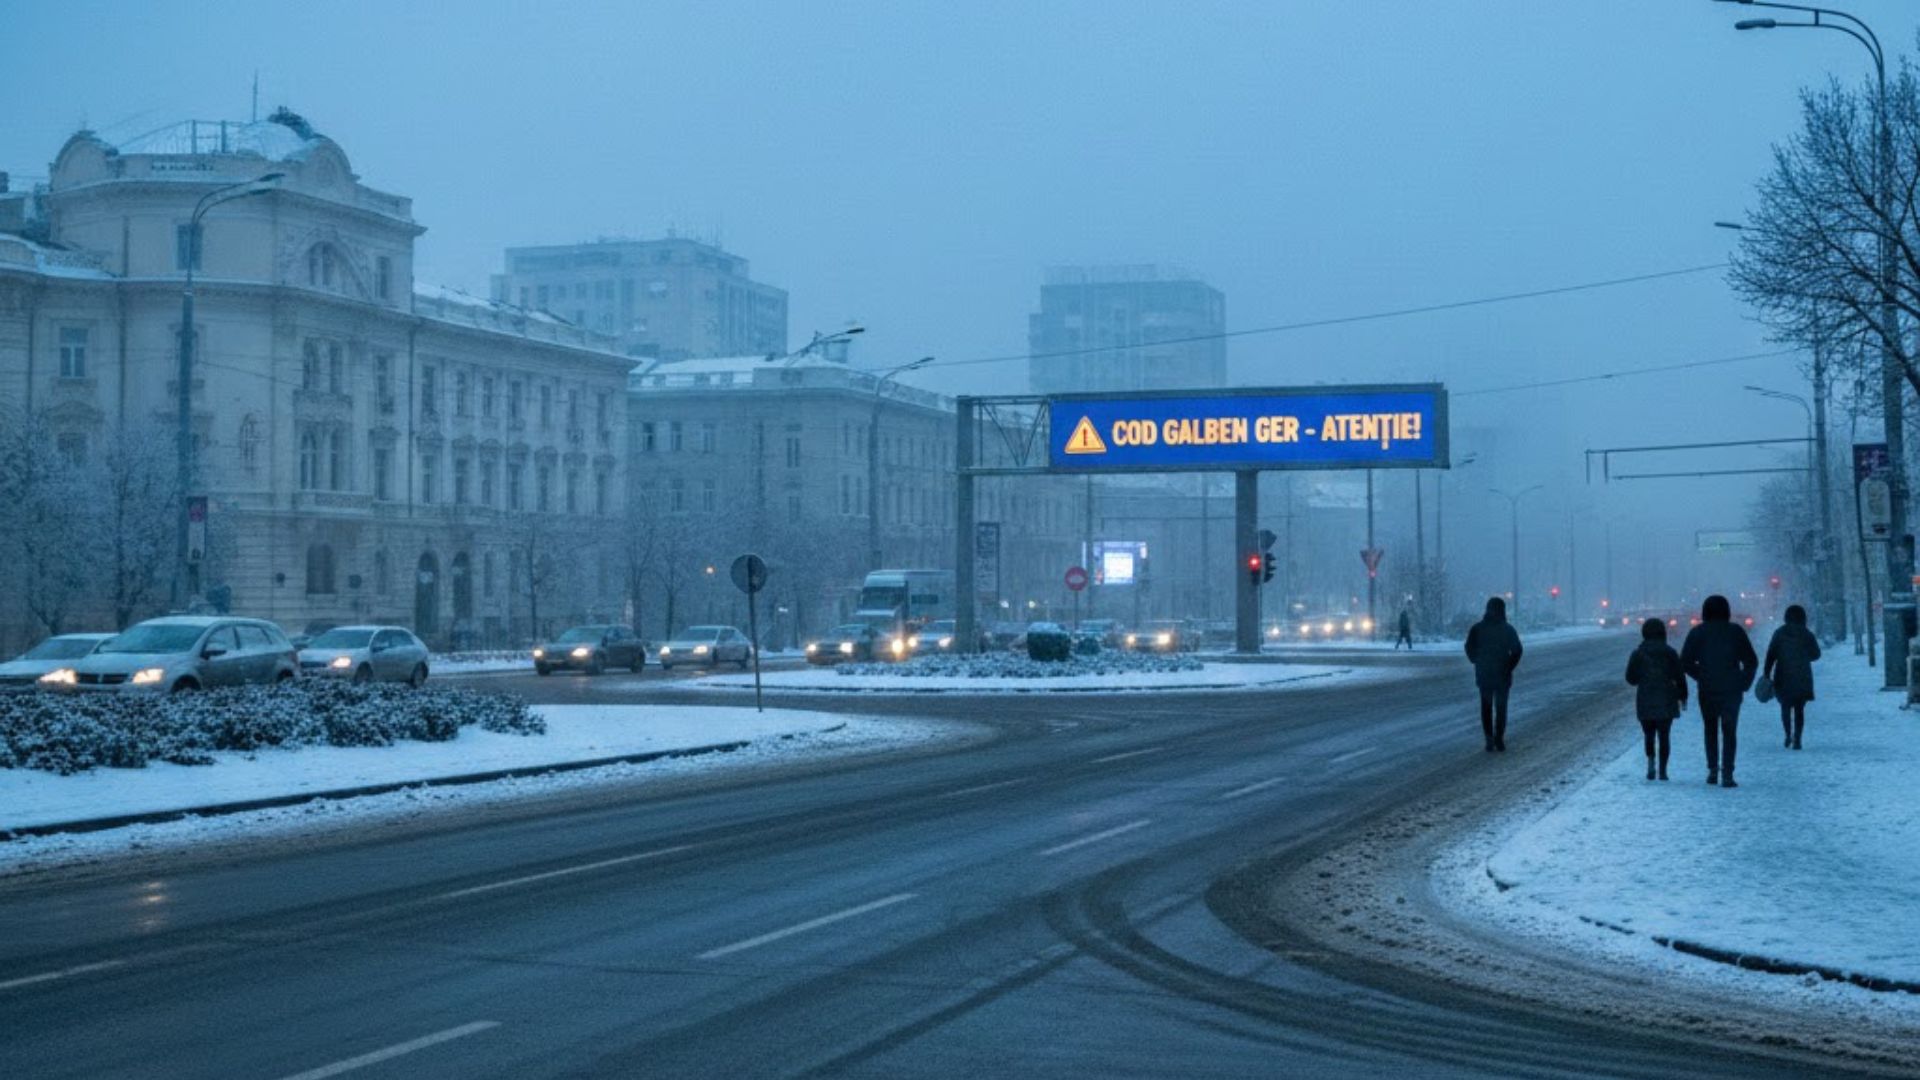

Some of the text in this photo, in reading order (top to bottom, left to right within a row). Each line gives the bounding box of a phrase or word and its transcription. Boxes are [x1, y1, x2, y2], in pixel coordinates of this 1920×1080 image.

[1112, 420, 1157, 446] COD
[1163, 418, 1248, 445] GALBEN
[1255, 416, 1299, 443] GER
